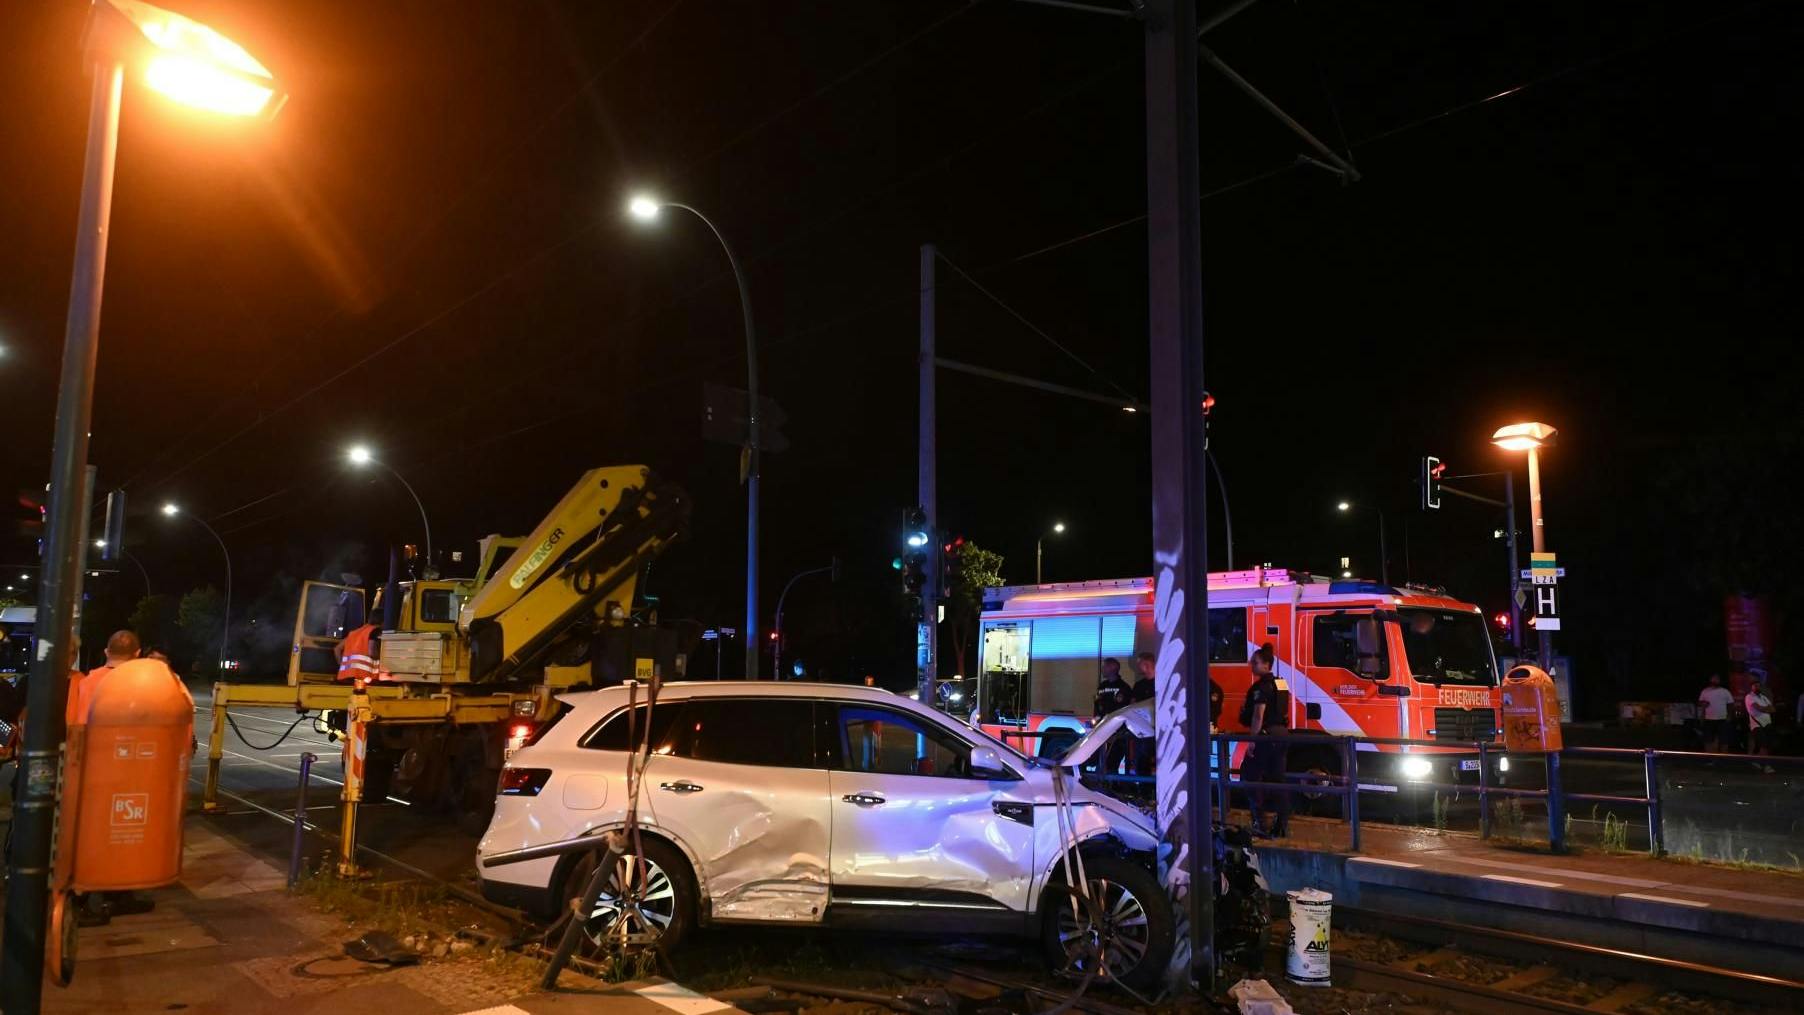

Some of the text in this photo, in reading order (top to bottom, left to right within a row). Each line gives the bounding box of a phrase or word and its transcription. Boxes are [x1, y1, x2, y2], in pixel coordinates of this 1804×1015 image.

[512, 528, 564, 585] PALFINGER
[1537, 587, 1556, 615] H
[1438, 689, 1491, 706] FEUERWEHR
[115, 799, 145, 820] BSR
